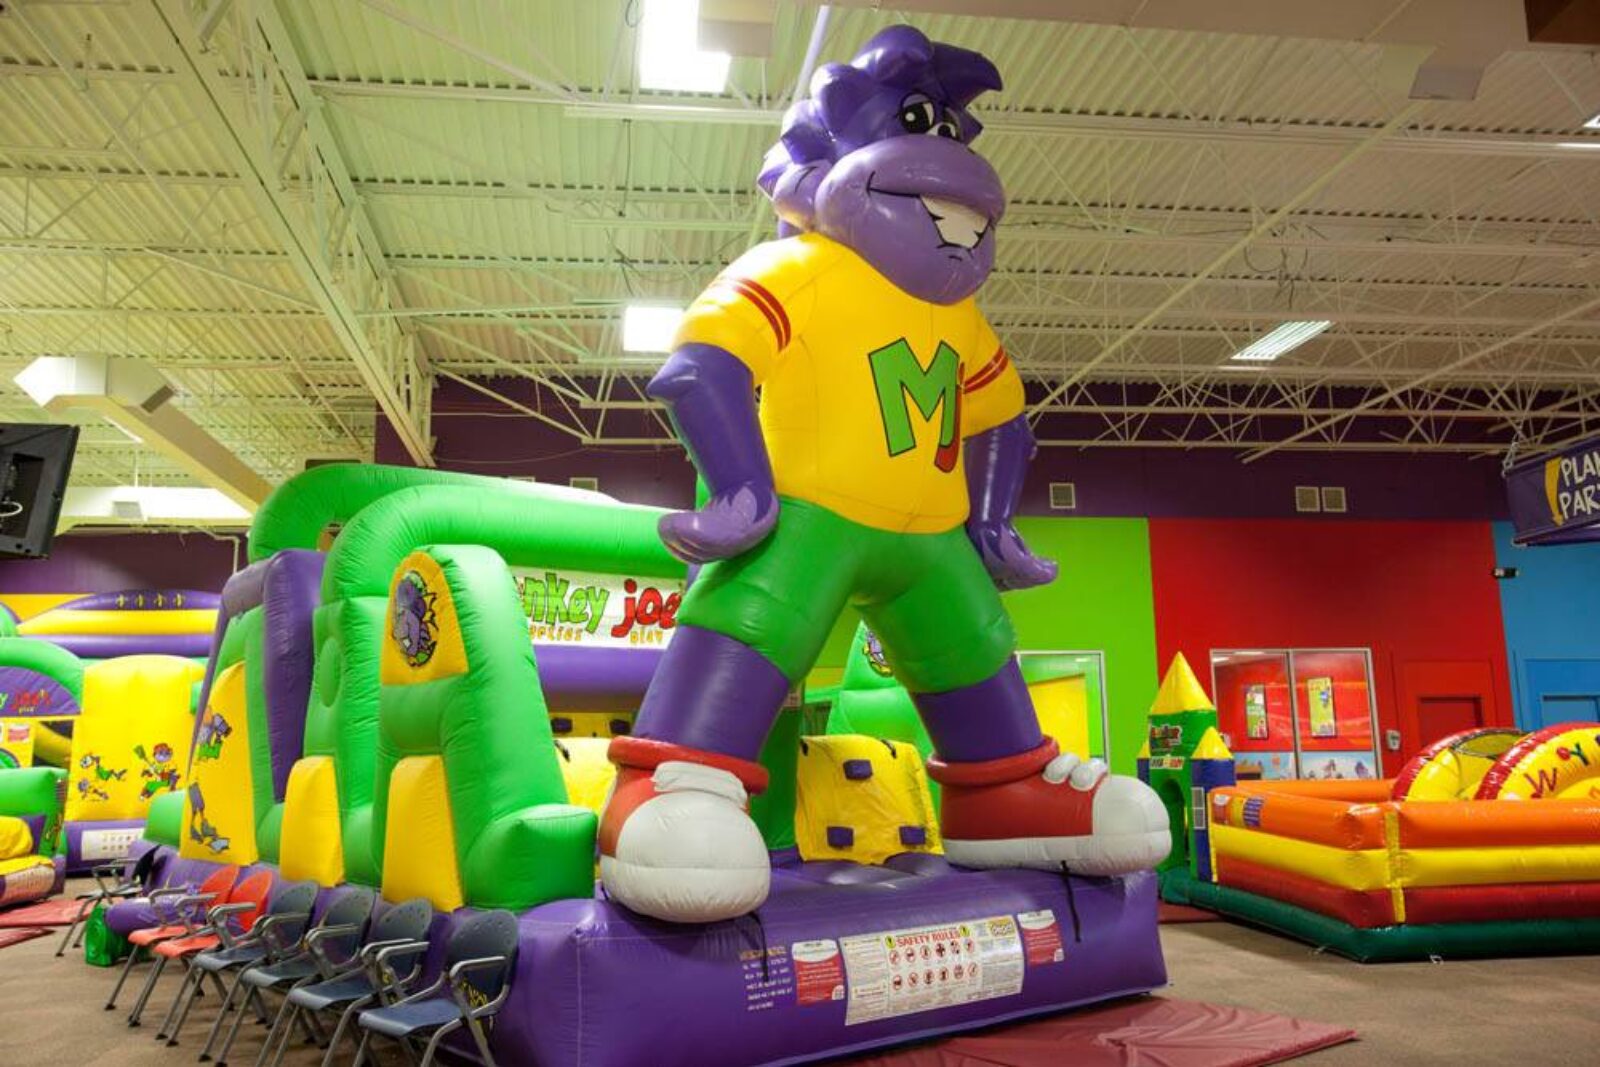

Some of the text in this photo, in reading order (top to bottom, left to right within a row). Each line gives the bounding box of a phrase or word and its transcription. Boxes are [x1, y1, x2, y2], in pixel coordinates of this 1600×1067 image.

[518, 572, 684, 638] nkey joe
[896, 935, 931, 948] SAFETY
